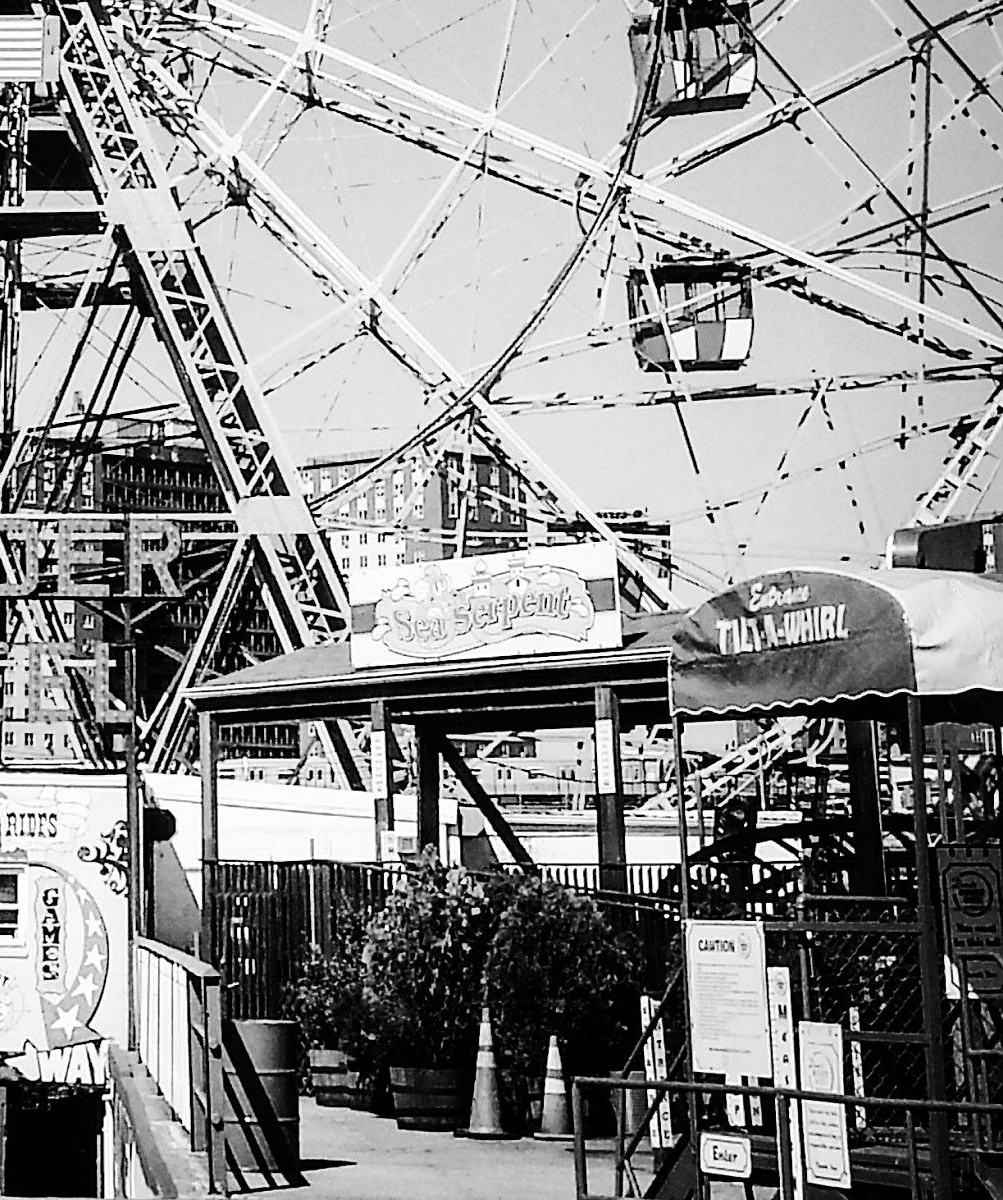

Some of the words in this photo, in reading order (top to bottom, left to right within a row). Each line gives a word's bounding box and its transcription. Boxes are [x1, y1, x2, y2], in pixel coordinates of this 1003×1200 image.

[393, 608, 447, 641] Sea
[453, 587, 572, 636] Serpent
[716, 604, 849, 655] TILT-A-WHIRL
[5, 812, 58, 838] RIDES
[42, 888, 59, 981] GAMES
[698, 939, 735, 953] CAUTION
[37, 1040, 110, 1085] WAY
